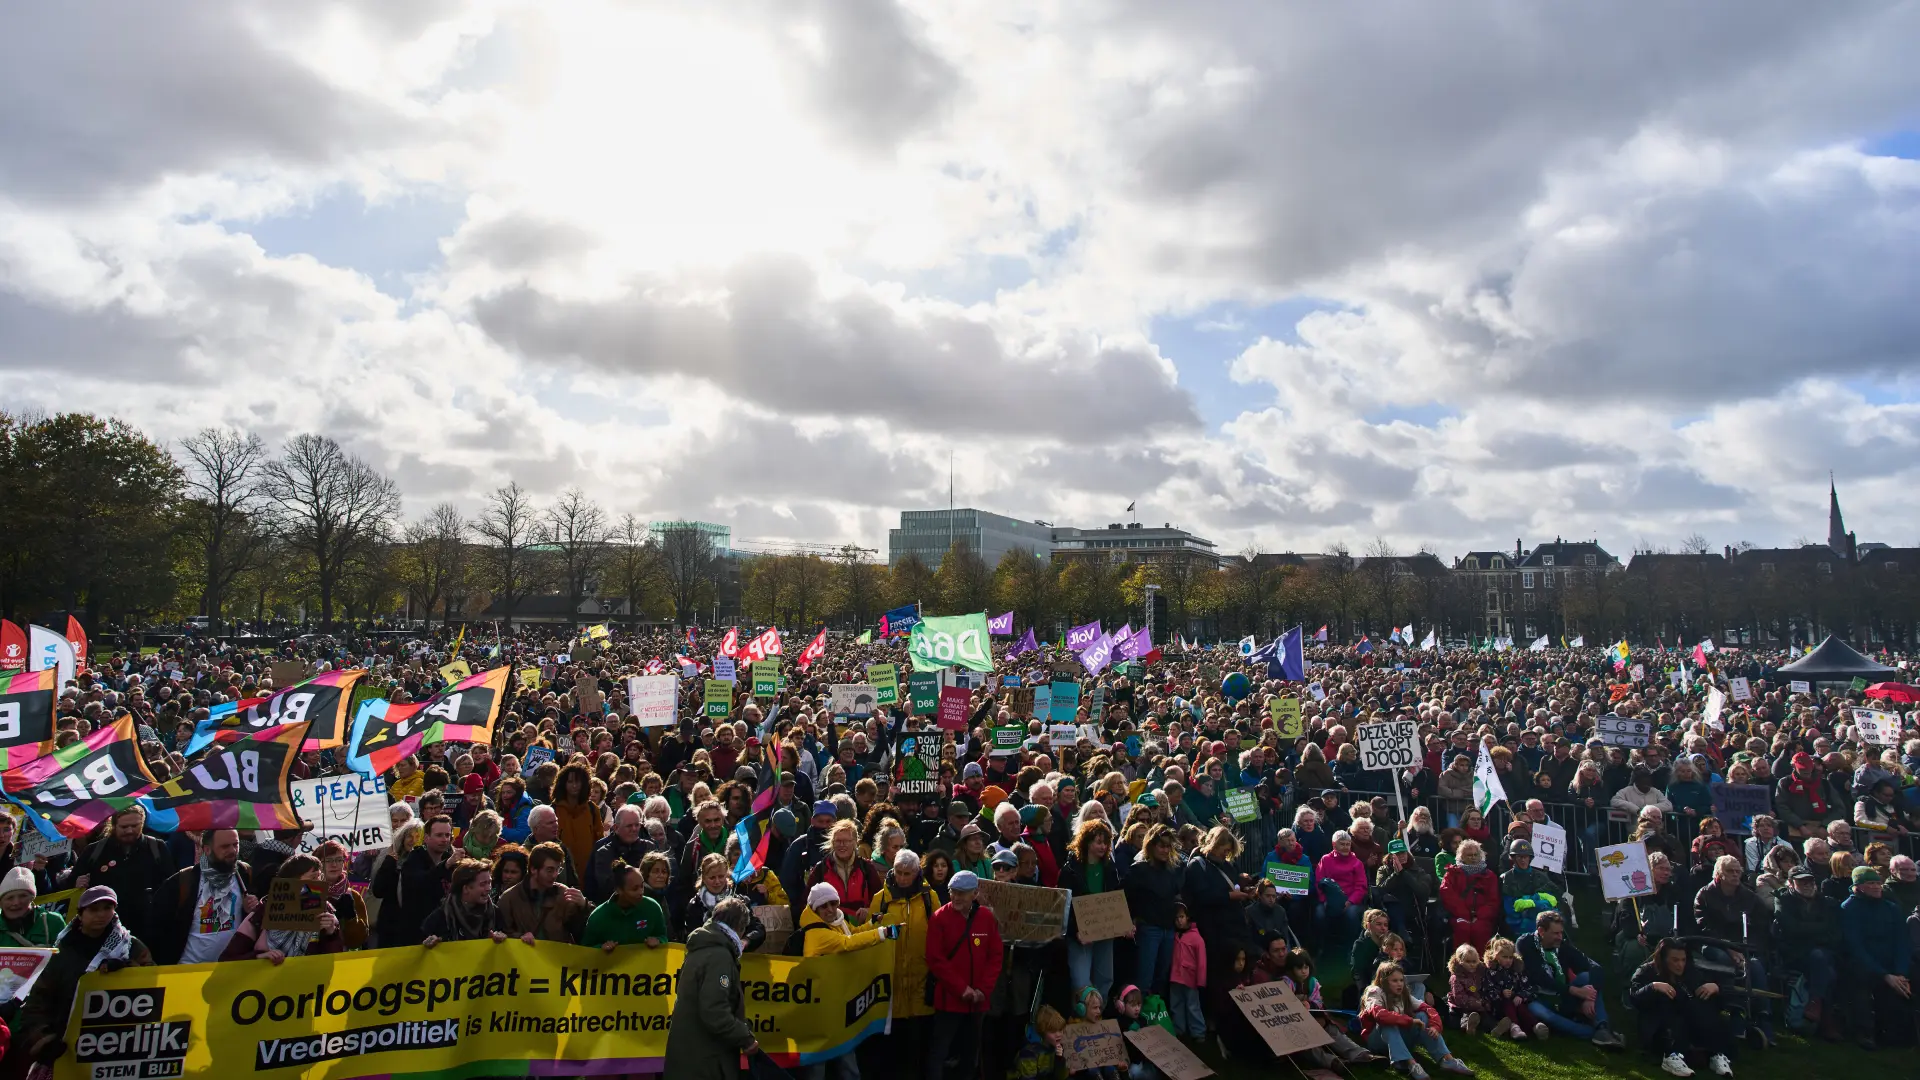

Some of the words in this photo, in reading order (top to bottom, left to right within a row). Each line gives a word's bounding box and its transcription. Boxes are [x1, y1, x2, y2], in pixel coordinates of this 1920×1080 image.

[876, 690, 894, 699] D66
[917, 699, 934, 708] D66
[942, 702, 968, 710] CLIMATE
[944, 708, 964, 716] GREAT
[917, 736, 942, 744] DON'T
[1360, 724, 1388, 742] DEZE
[1392, 722, 1413, 737] WEG
[920, 744, 940, 756] STOP
[1370, 736, 1412, 752] LOOPT
[918, 753, 940, 770] TALKING
[1365, 748, 1413, 768] DOOD
[314, 776, 387, 804] PEACE
[274, 882, 290, 892] NO
[270, 902, 285, 911] NO
[269, 914, 314, 922] WARMING
[231, 967, 520, 1026] Oorloogspraat
[528, 978, 550, 994] =
[855, 976, 888, 1018] BIJ1
[1253, 986, 1282, 1000] WILLEN
[82, 990, 154, 1019] Doe
[1250, 1004, 1270, 1018] OOK
[1271, 1002, 1288, 1013] EEN
[1150, 1011, 1168, 1022] kpn
[1260, 1012, 1304, 1028] TOEKOMST
[76, 1021, 188, 1060] eerlijk.
[258, 1018, 460, 1064] Vredespolitiek
[466, 1014, 482, 1037] is
[95, 1064, 136, 1078] STEM
[148, 1060, 179, 1076] BIJ1
